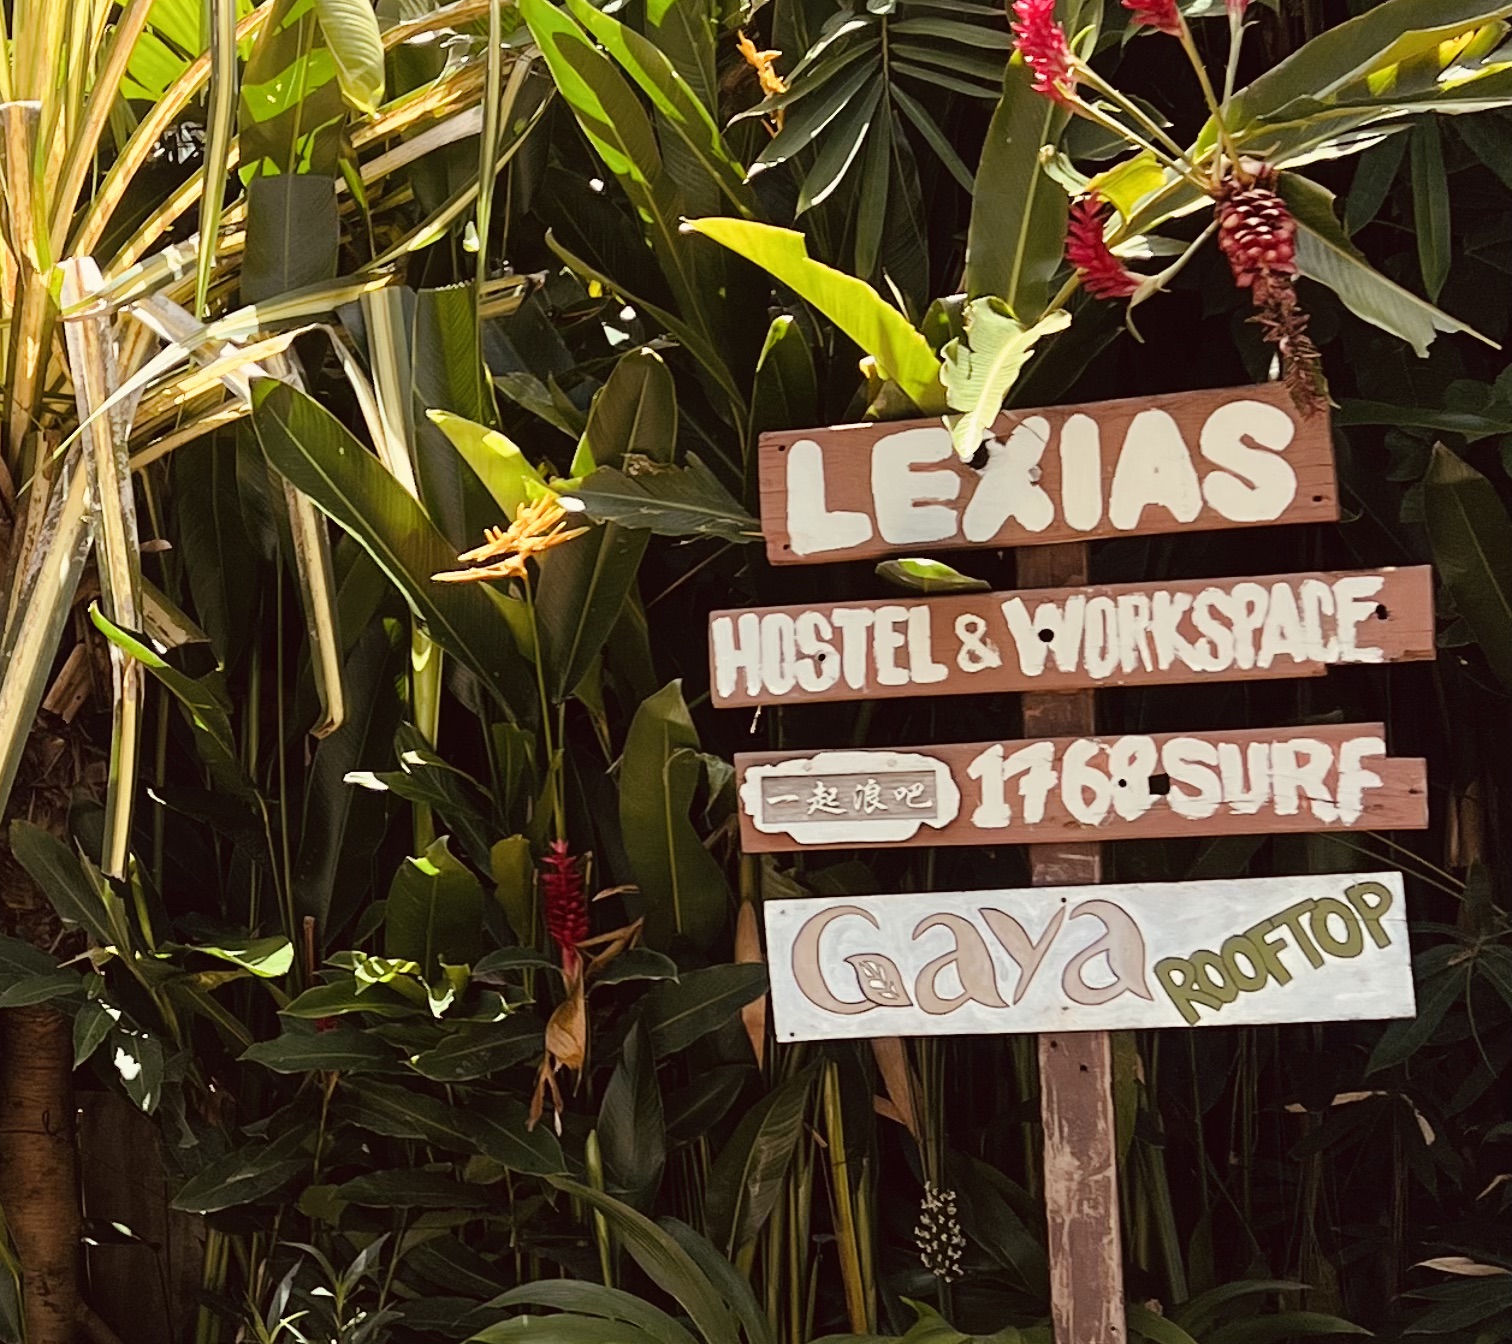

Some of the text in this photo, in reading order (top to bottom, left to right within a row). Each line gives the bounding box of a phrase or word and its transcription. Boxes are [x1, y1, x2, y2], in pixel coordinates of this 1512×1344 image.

[787, 400, 1297, 556] LEXIAS
[712, 575, 1386, 698] HOSTEL & WORKSPACE
[766, 778, 933, 815] 一起浪吧
[791, 881, 1393, 1026] Gaya ROOFTOP
